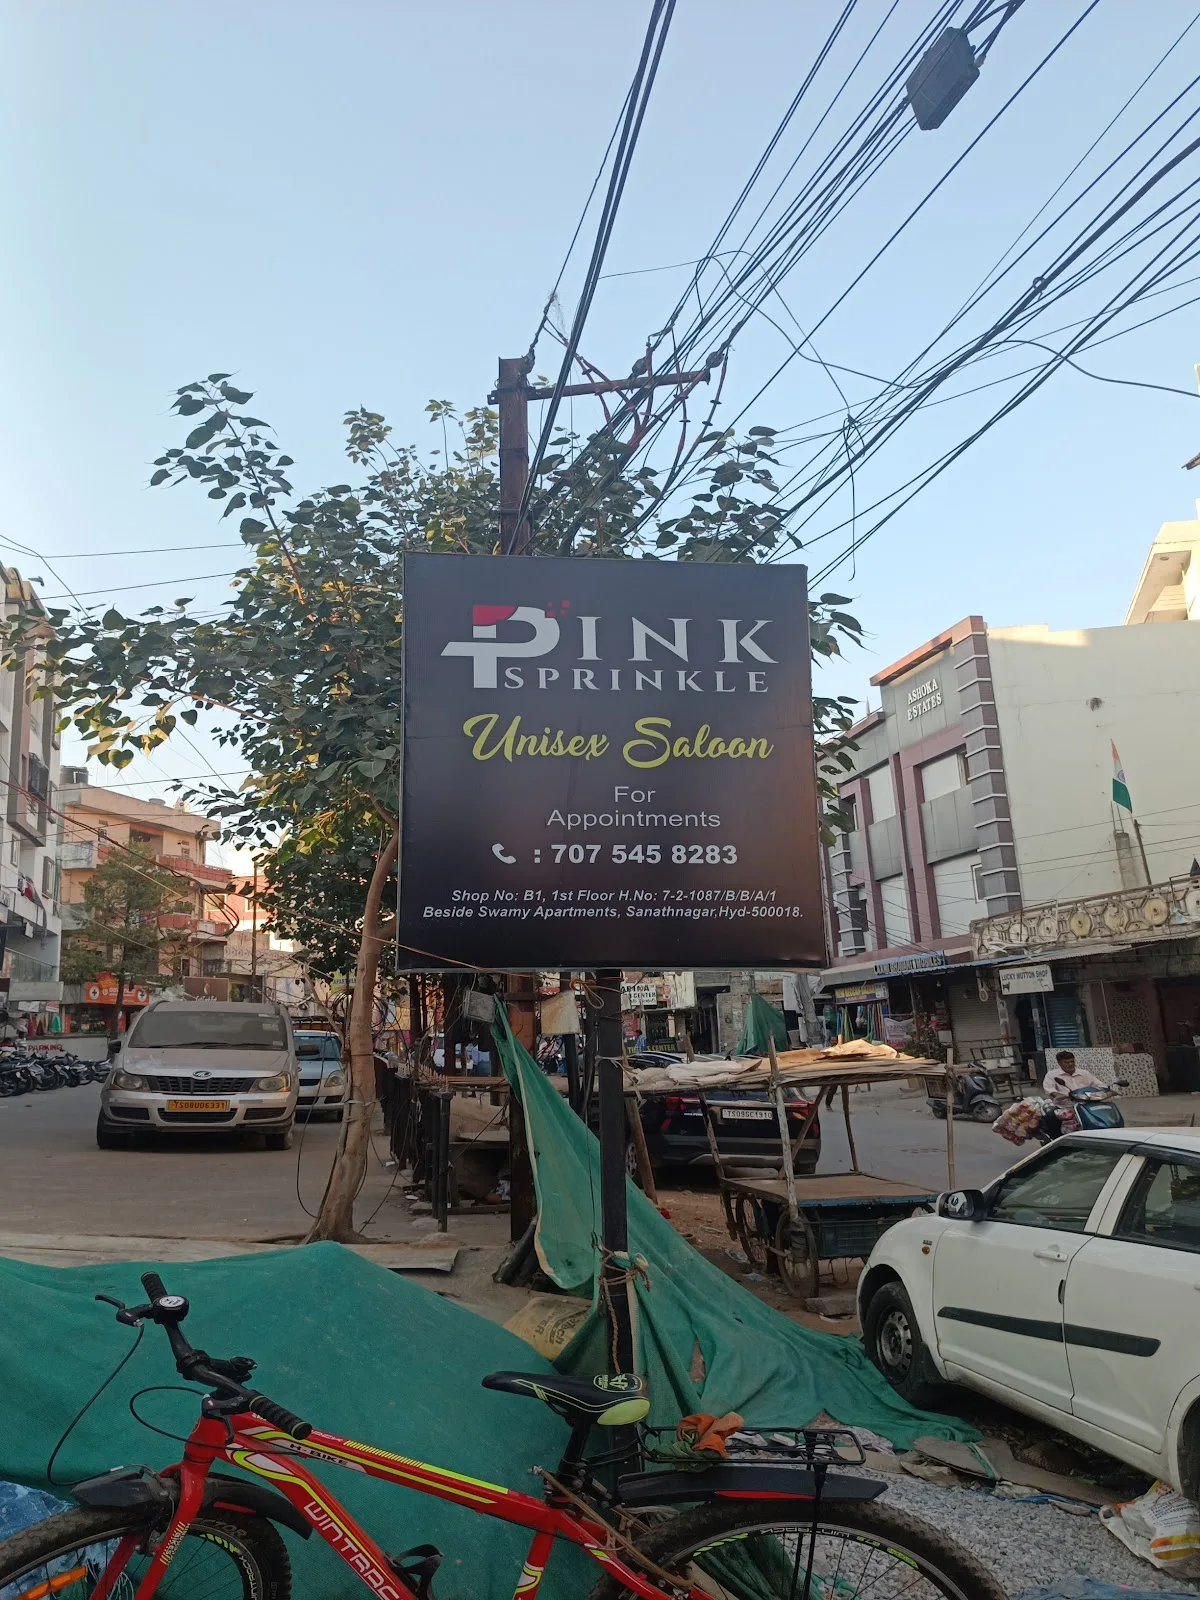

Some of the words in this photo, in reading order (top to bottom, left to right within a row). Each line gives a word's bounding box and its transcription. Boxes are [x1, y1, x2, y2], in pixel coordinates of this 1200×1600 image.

[440, 605, 780, 689] PINK
[504, 667, 769, 693] SPRINKLE
[908, 679, 939, 705] ASHOKA
[907, 692, 942, 721] ESTATES
[463, 714, 609, 762] Unisex
[622, 717, 774, 768] Saloon
[614, 786, 656, 803] For
[547, 809, 721, 830] Appointments
[551, 844, 602, 864] 707
[611, 844, 662, 864] 545
[671, 845, 738, 865] 8283
[451, 889, 490, 903] Shop
[494, 889, 519, 901] No:
[523, 889, 547, 903] B1,
[551, 889, 573, 901] 1st
[577, 889, 615, 901] Floor
[618, 889, 658, 901] H.No:
[662, 889, 777, 902] 7-2-1087/B/B/A/1
[422, 906, 474, 918] Beside
[478, 906, 530, 920] Swamy
[533, 906, 621, 920] Apartments,
[626, 905, 804, 920] Sanathnagar,Hyd-500018.
[1001, 972, 1016, 981] LUCKY
[1016, 971, 1035, 980] MUTTON
[1036, 969, 1049, 978] SHOP
[28, 1043, 64, 1052] PARKING
